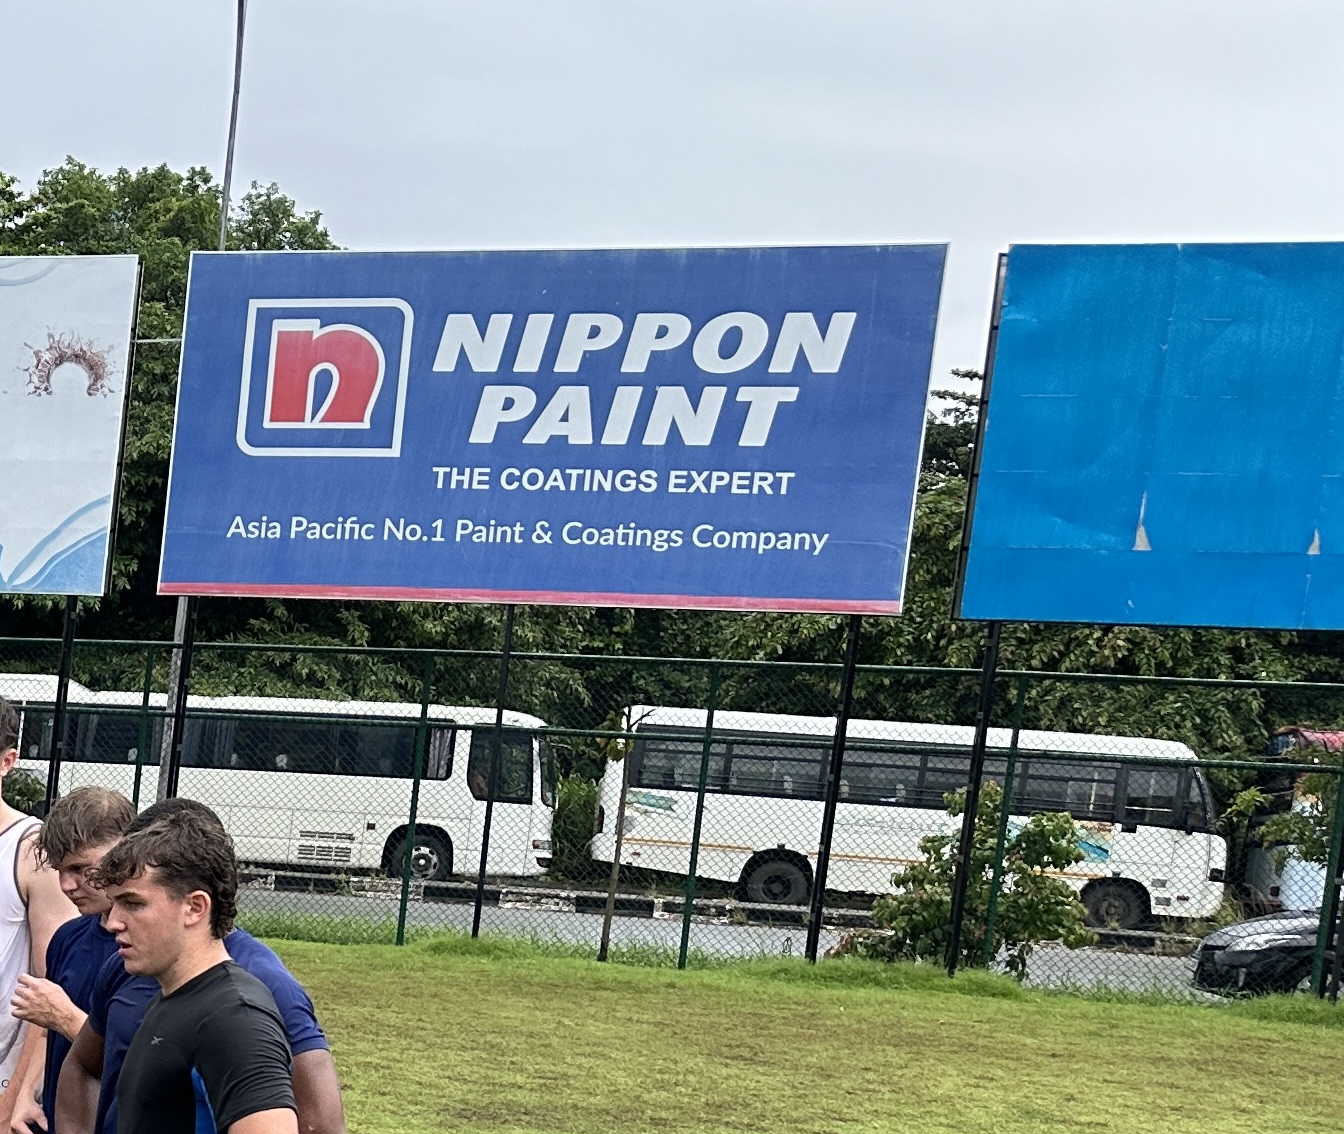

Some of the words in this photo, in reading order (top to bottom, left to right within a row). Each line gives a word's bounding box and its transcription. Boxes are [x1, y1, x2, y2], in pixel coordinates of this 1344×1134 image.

[432, 312, 857, 374] NIPPON
[468, 385, 800, 447] PAINT
[432, 466, 491, 490] THE
[500, 467, 659, 493] COATINGS
[668, 470, 796, 495] EXPERT
[226, 515, 282, 539] Asia
[290, 516, 375, 541] Pacific
[383, 517, 446, 542] No.1
[455, 518, 524, 543] Paint
[532, 520, 553, 544] &
[561, 521, 684, 552] Coatings
[692, 523, 830, 556] Company
